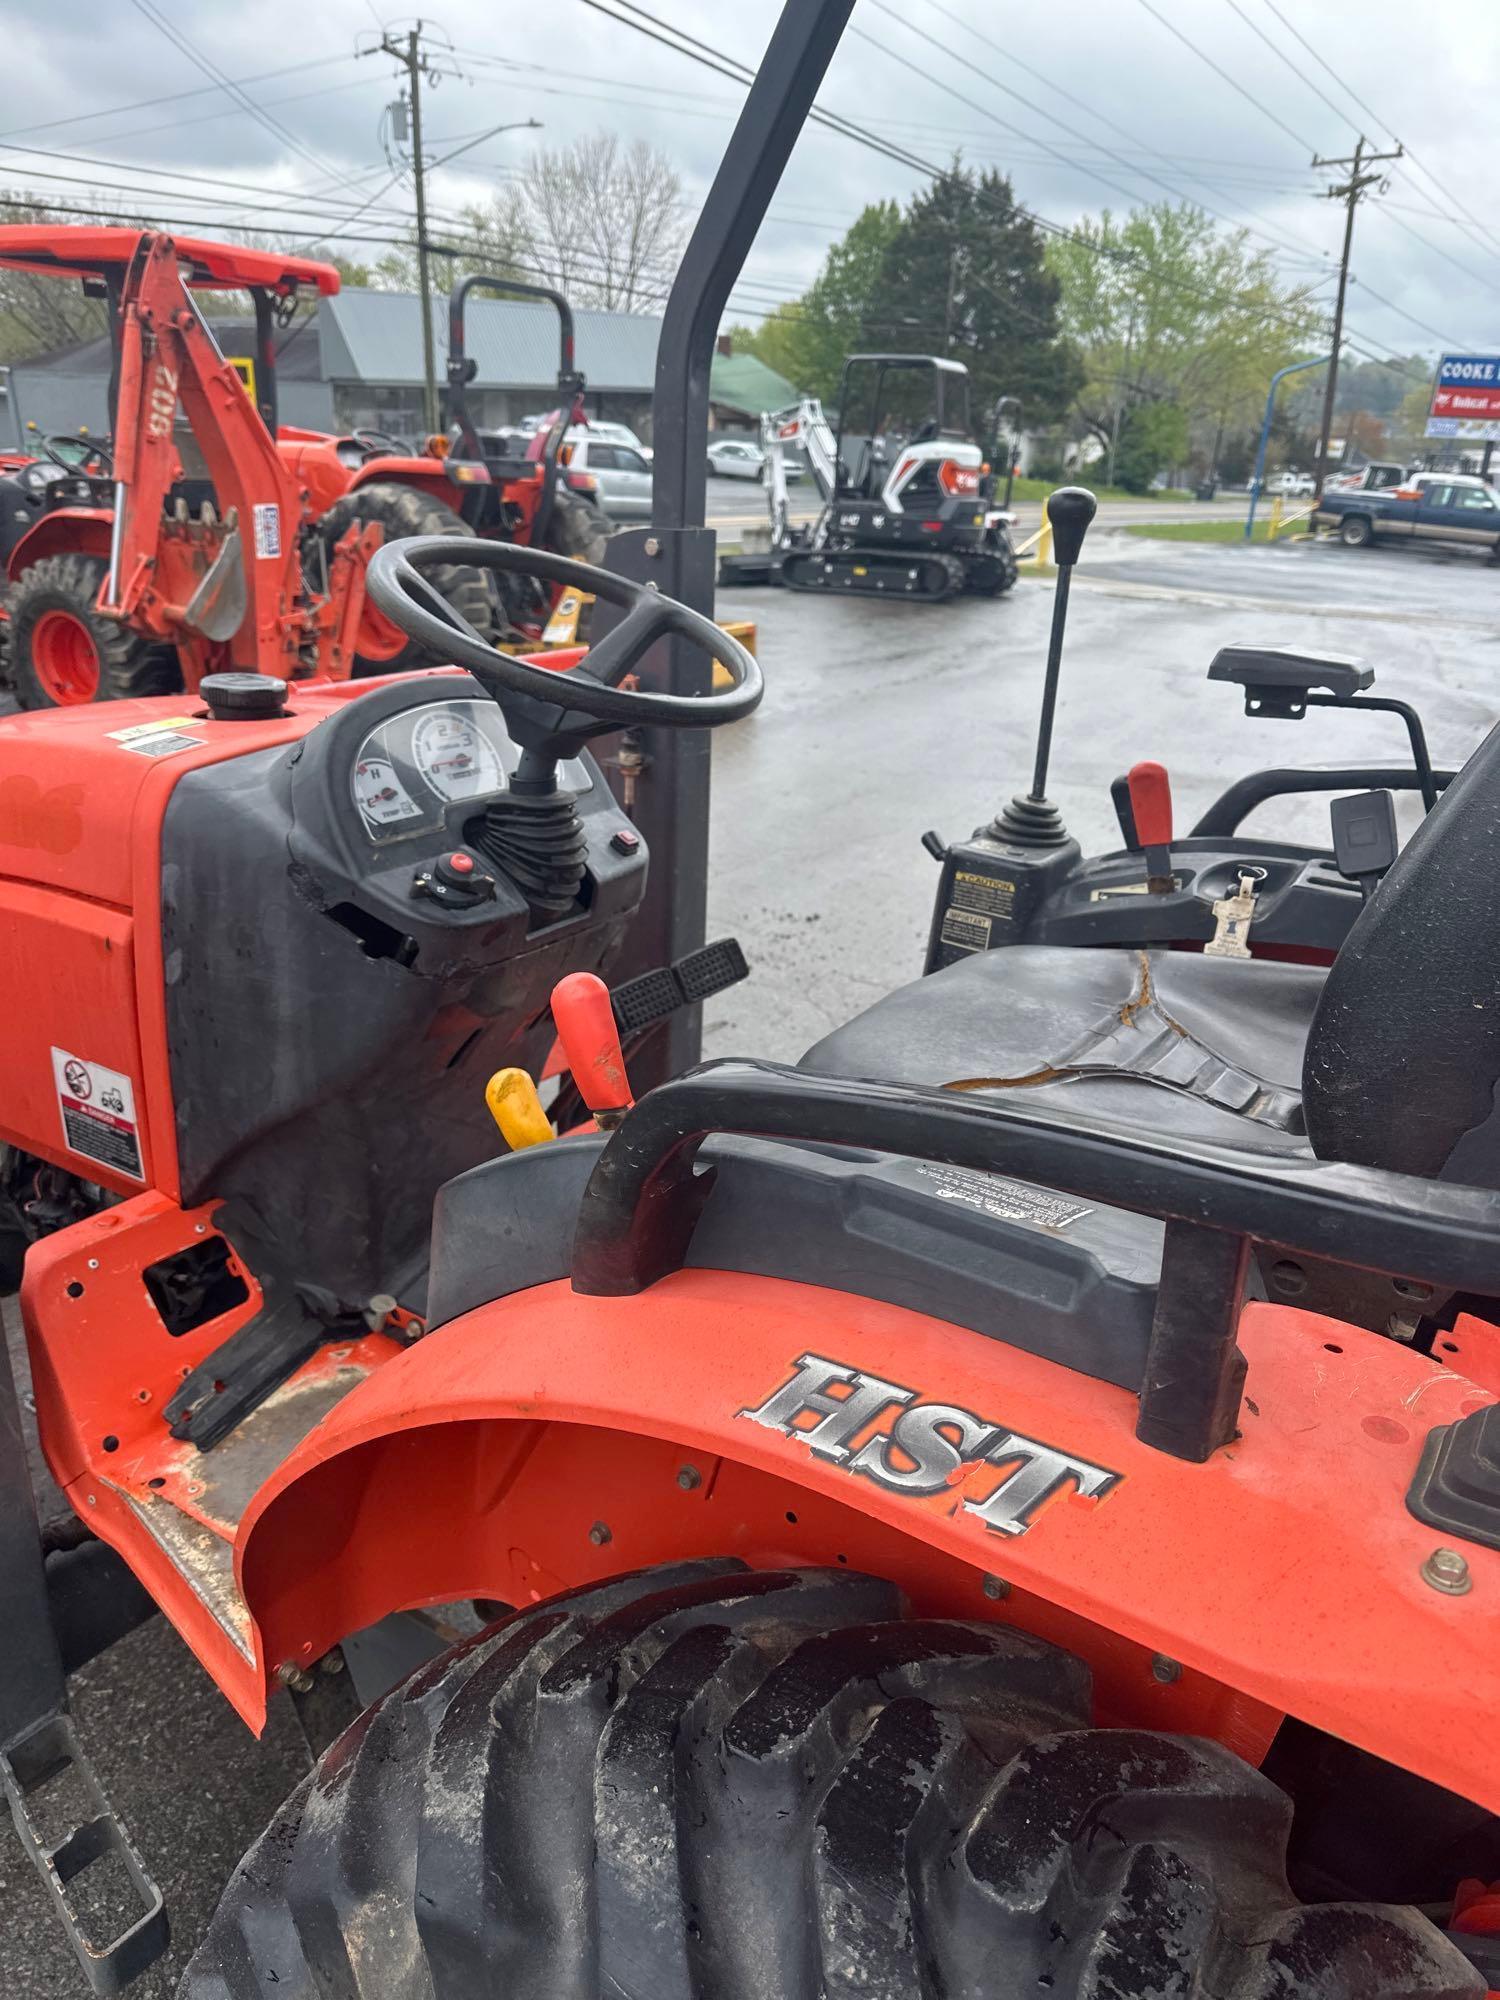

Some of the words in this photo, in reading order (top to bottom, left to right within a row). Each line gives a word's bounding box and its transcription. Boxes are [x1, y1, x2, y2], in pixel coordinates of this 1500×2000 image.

[1441, 362, 1495, 380] COOKE
[437, 724, 448, 737] 2
[461, 732, 473, 747] 3
[371, 768, 381, 779] H
[968, 875, 1011, 890] CAUTION
[951, 911, 988, 927] IMPORTANT
[87, 1106, 116, 1125] DANGER
[733, 1352, 1122, 1536] HST
